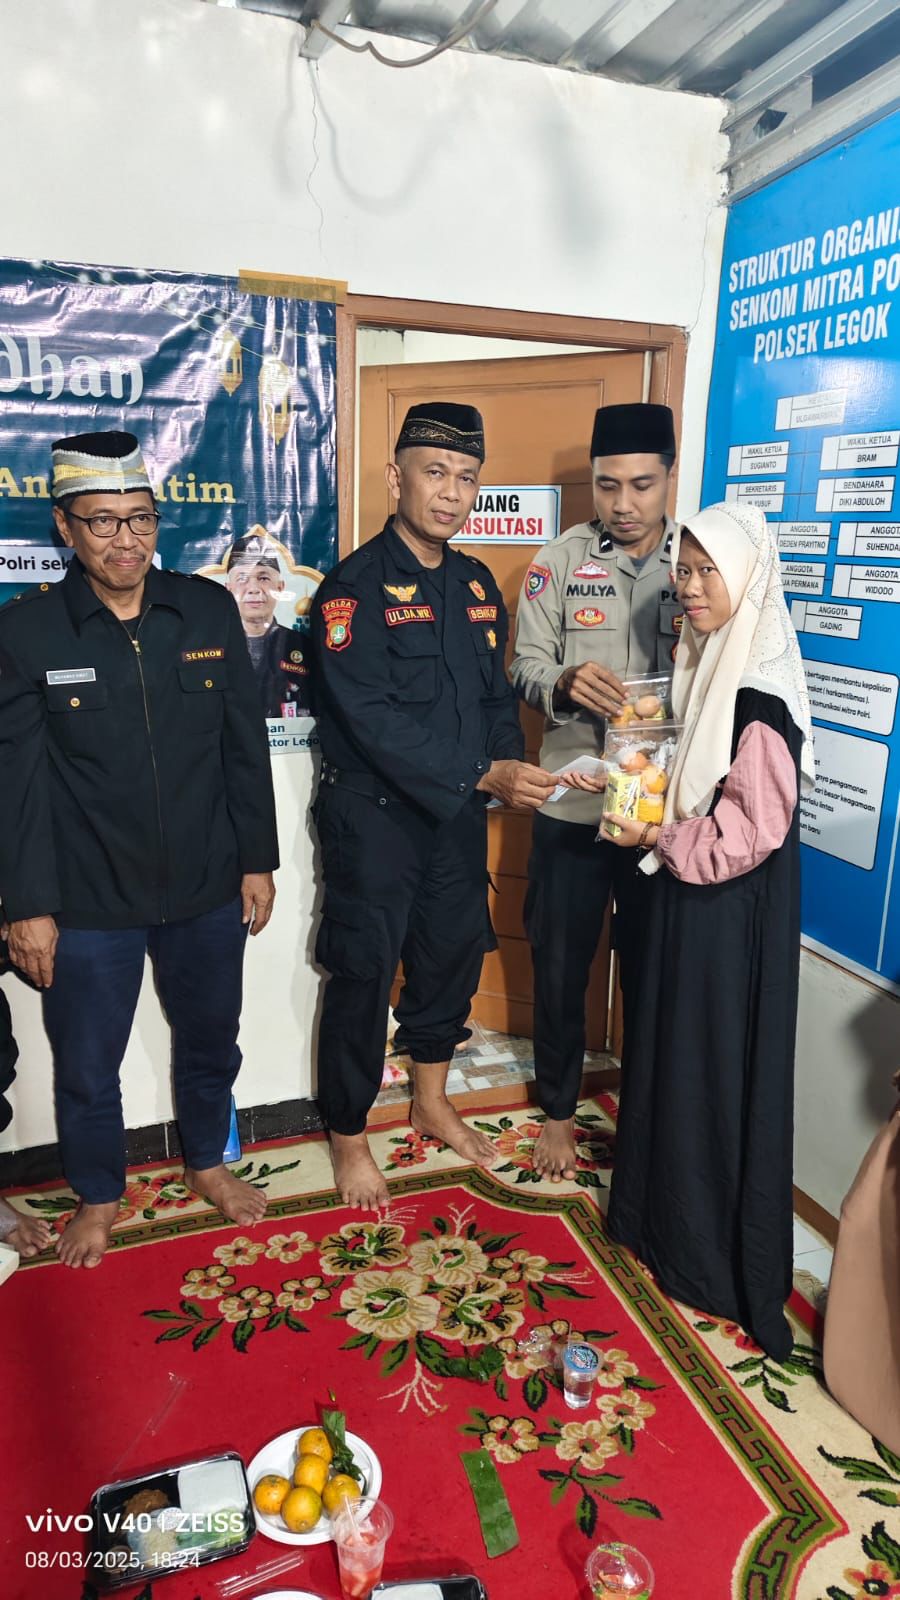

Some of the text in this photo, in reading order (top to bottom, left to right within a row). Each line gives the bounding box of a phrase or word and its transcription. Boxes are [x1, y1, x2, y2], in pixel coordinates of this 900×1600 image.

[729, 206, 900, 293] STRUKTUR ORGANI
[729, 283, 798, 331] SENKOM
[802, 264, 864, 312] MITRA
[753, 302, 892, 364] POLSEK LEGOK
[869, 435, 892, 445] KETUA
[764, 446, 782, 454] KETUA
[857, 453, 877, 463] BRAM
[750, 461, 777, 470] SUGIANTO
[745, 485, 777, 493] SEKRETARIS
[843, 479, 885, 489] BENDAHARA
[839, 496, 886, 506] DIKI ABDULOH
[790, 525, 818, 533] ANGGOTA
[870, 526, 900, 535] ANGGOT
[866, 542, 900, 551] SUHENDA
[41, 556, 69, 570] sek
[786, 565, 813, 573] ANGGOTA
[865, 569, 899, 579] ANGGOTA
[566, 584, 617, 597] MULYA
[865, 586, 894, 595] WIDODO
[818, 606, 848, 616] ANGGOTA
[820, 621, 842, 631] GADING
[185, 649, 222, 660] SENKOM
[293, 737, 320, 748] Lego
